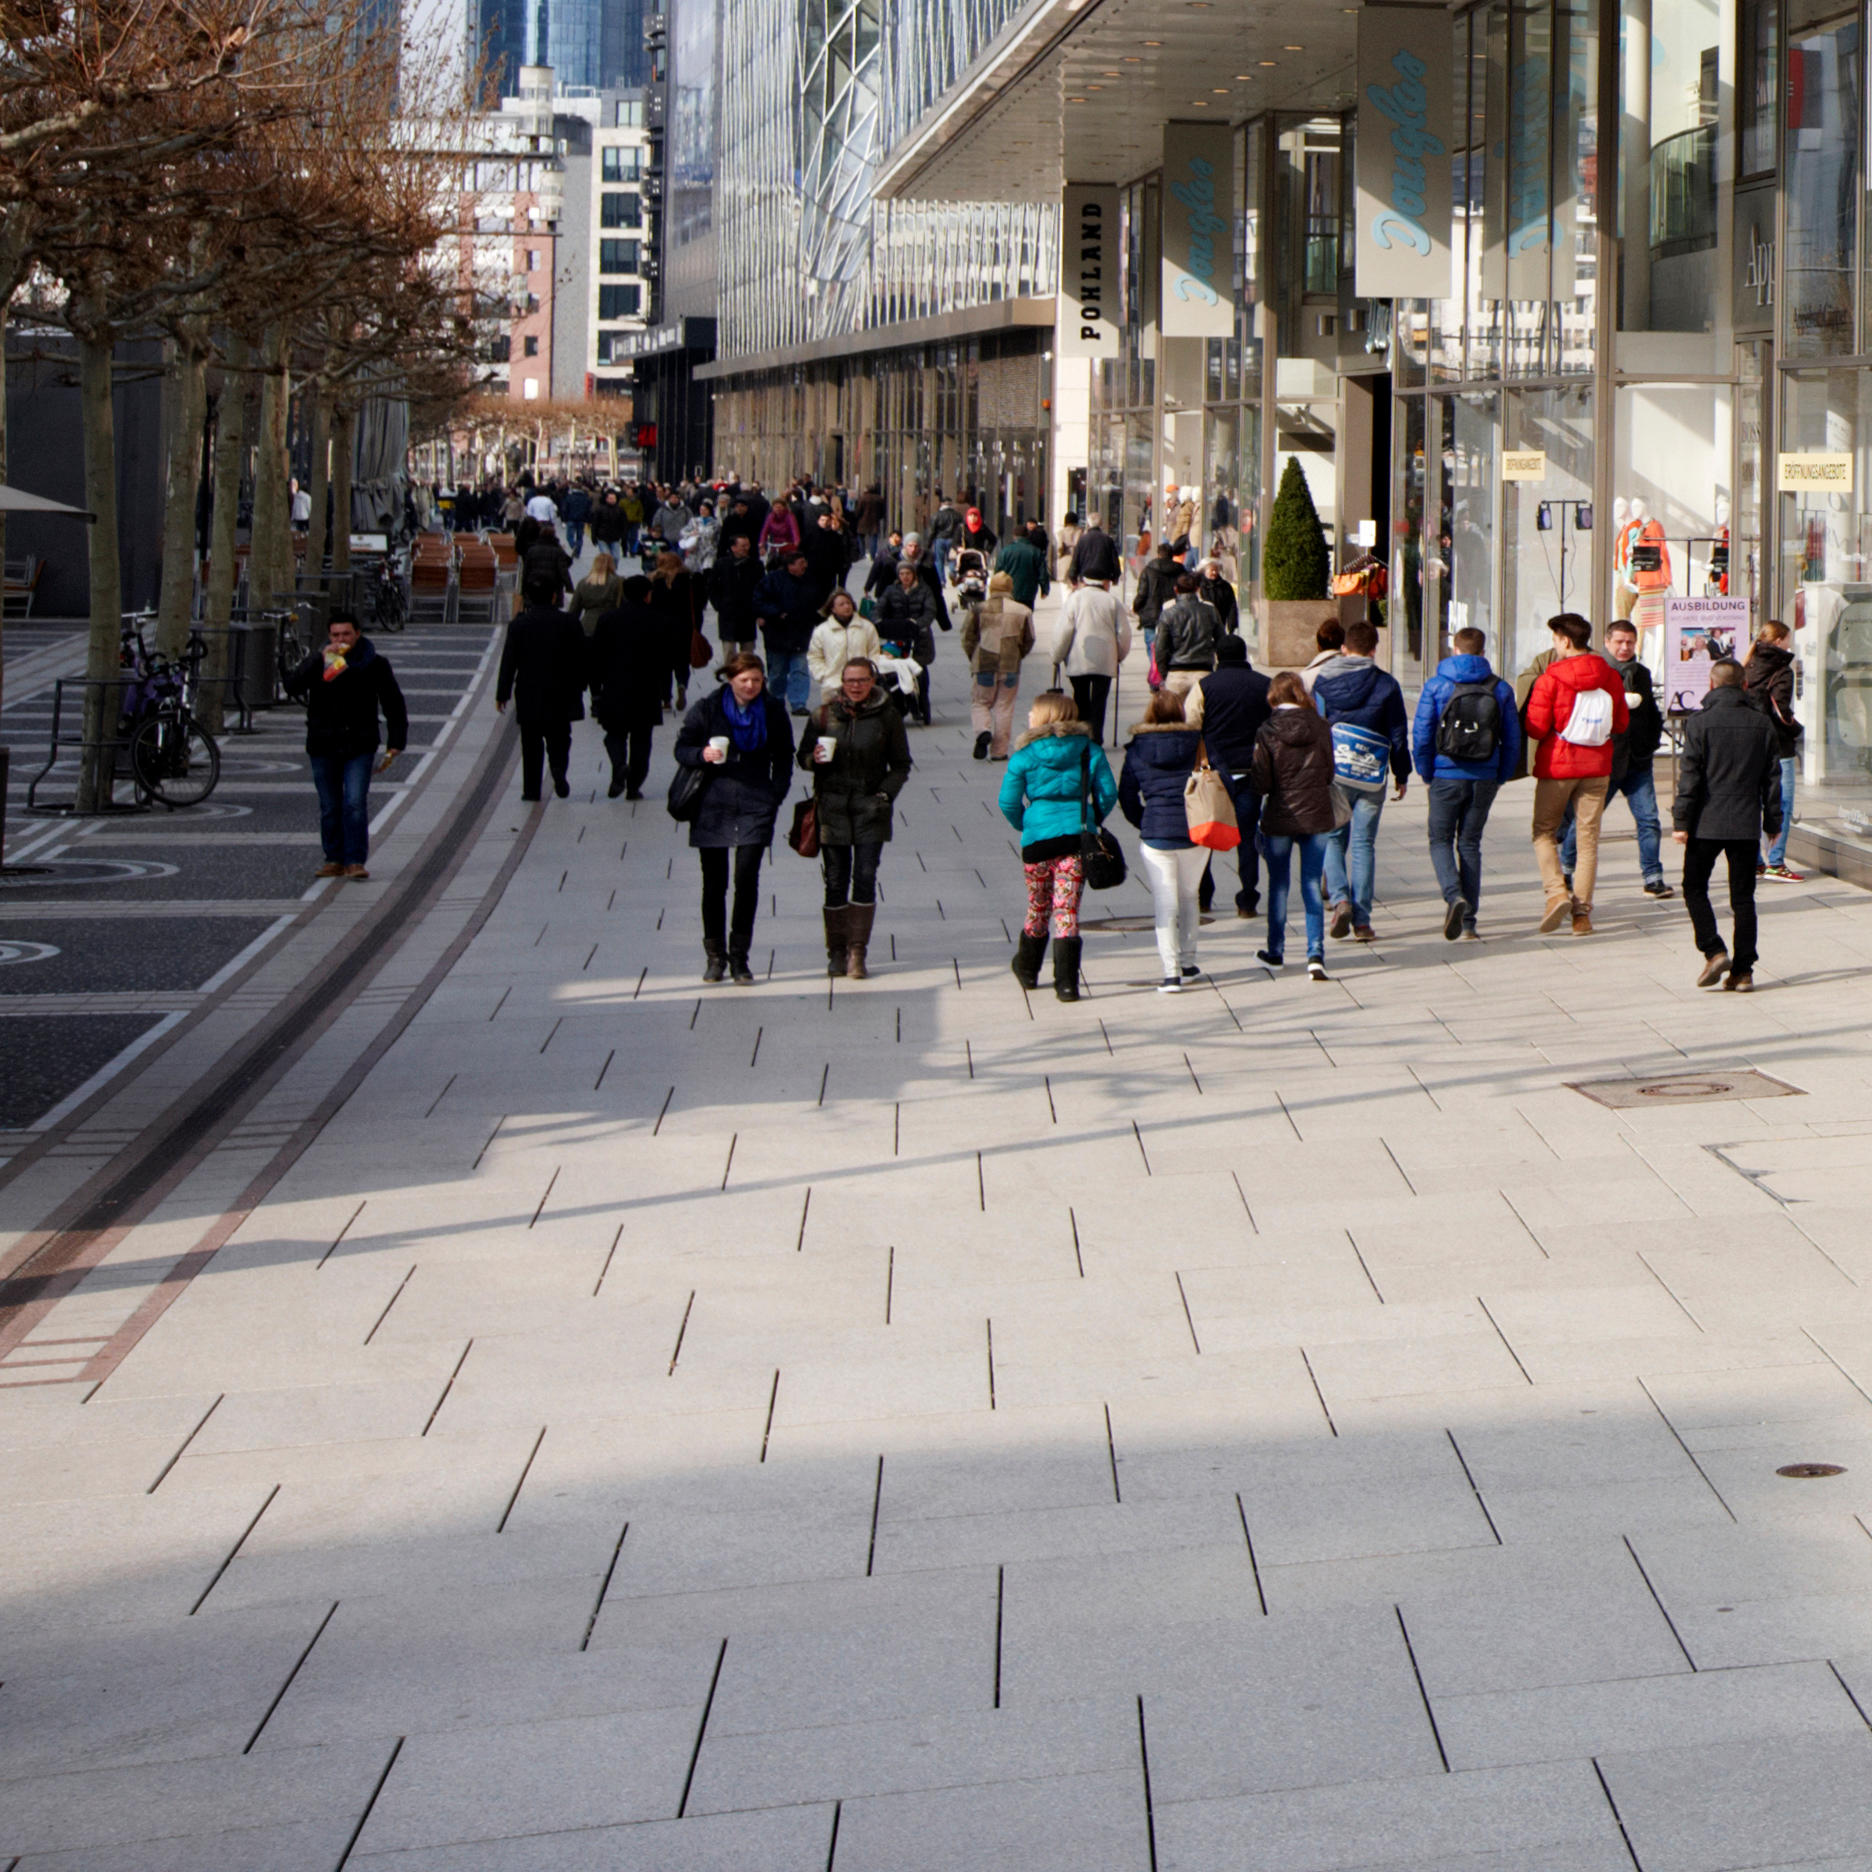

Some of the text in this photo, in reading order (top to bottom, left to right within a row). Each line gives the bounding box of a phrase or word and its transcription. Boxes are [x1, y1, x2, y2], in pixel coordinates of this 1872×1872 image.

[1366, 49, 1446, 257] Douglas
[1080, 202, 1102, 341] POHLAND
[1170, 156, 1227, 307] Douglas
[1671, 601, 1746, 612] AUSBILDUNG
